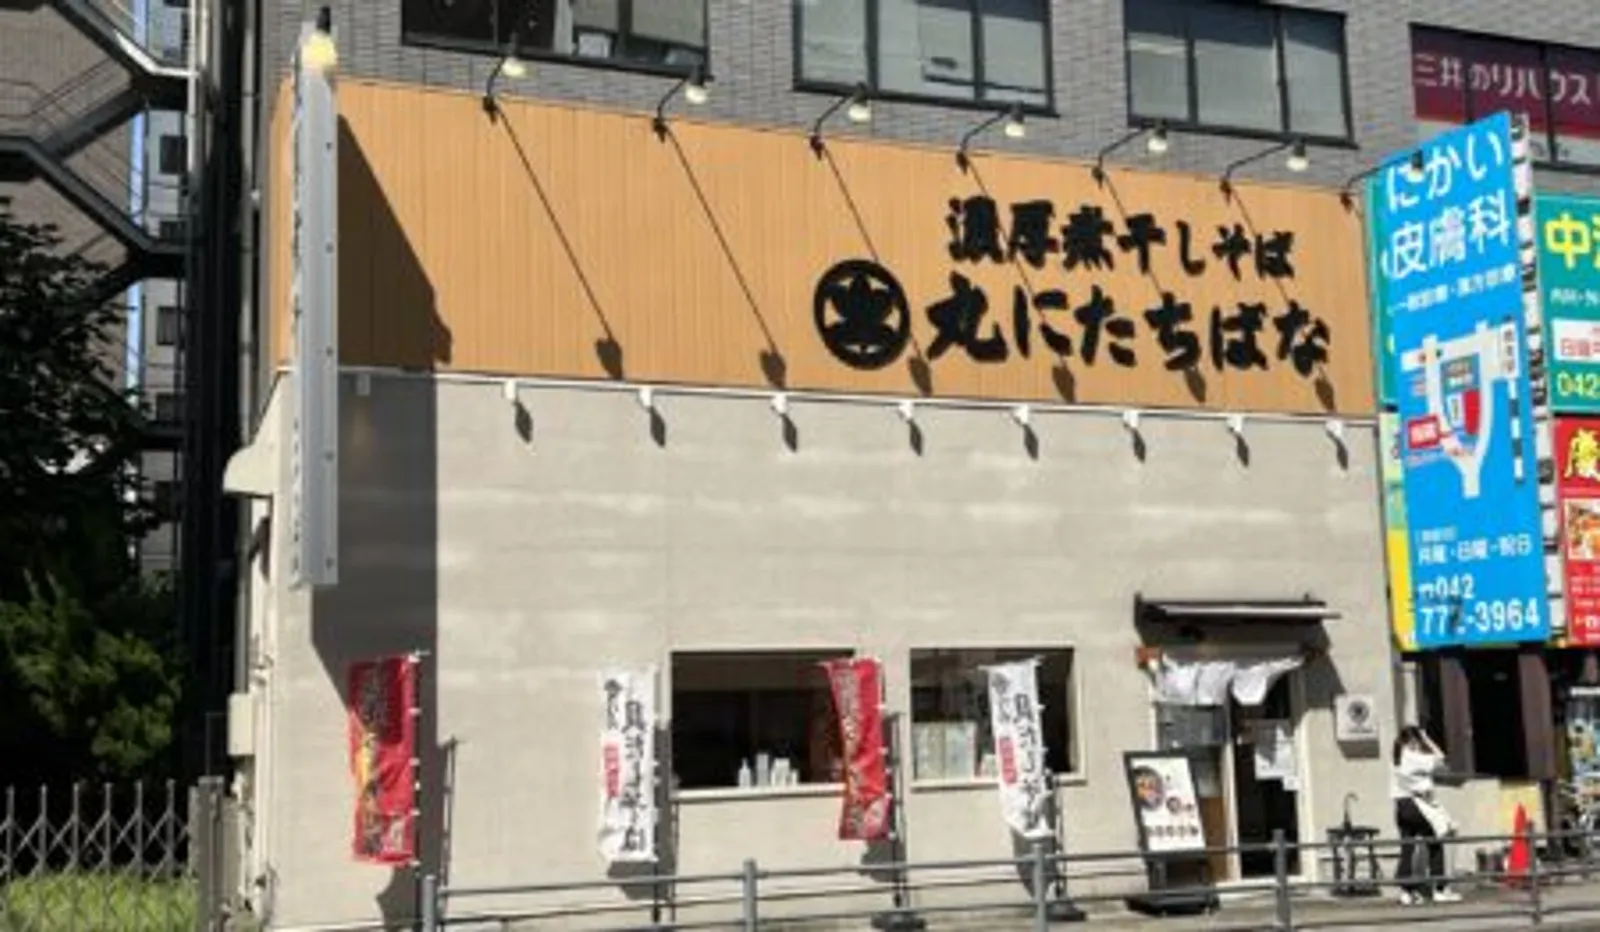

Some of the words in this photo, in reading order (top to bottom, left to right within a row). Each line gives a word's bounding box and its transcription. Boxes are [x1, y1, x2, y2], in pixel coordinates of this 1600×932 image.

[1385, 131, 1504, 213] にかい
[946, 194, 1296, 280] 濃厚煮干しそば
[1380, 188, 1512, 281] 皮膚科
[925, 270, 1332, 377] 丸にたちばな
